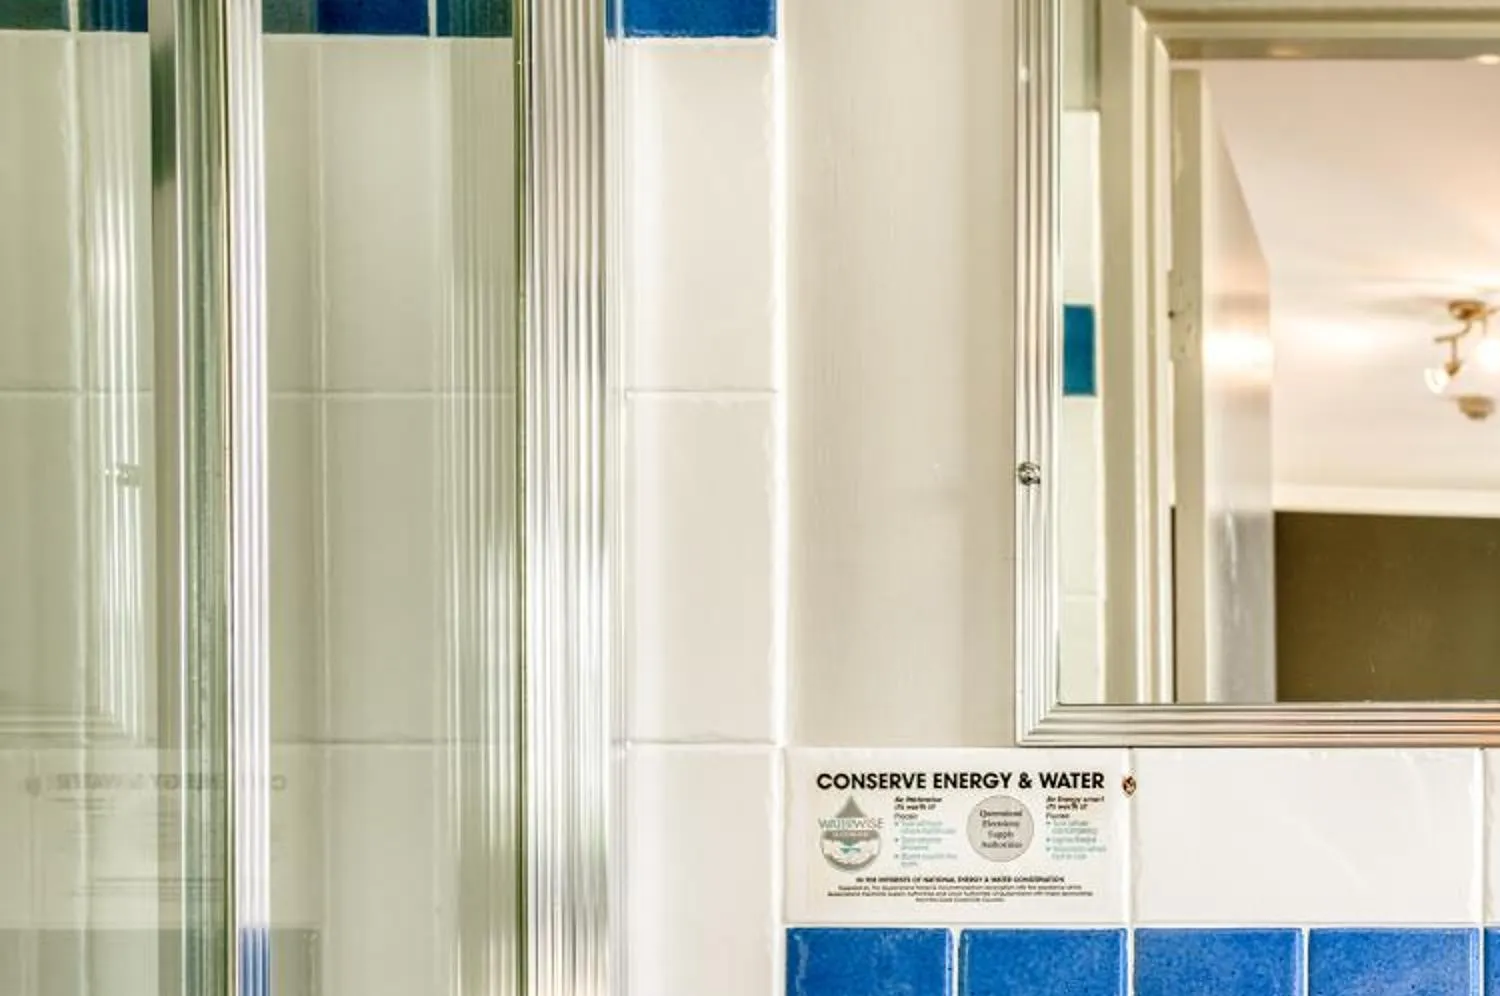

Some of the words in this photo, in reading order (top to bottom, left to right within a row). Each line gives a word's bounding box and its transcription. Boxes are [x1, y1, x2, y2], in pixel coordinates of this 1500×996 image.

[816, 773, 926, 790] CONSERVE
[933, 773, 1012, 789] ENERGY
[1019, 773, 1032, 789] &
[1039, 773, 1105, 789] WATER
